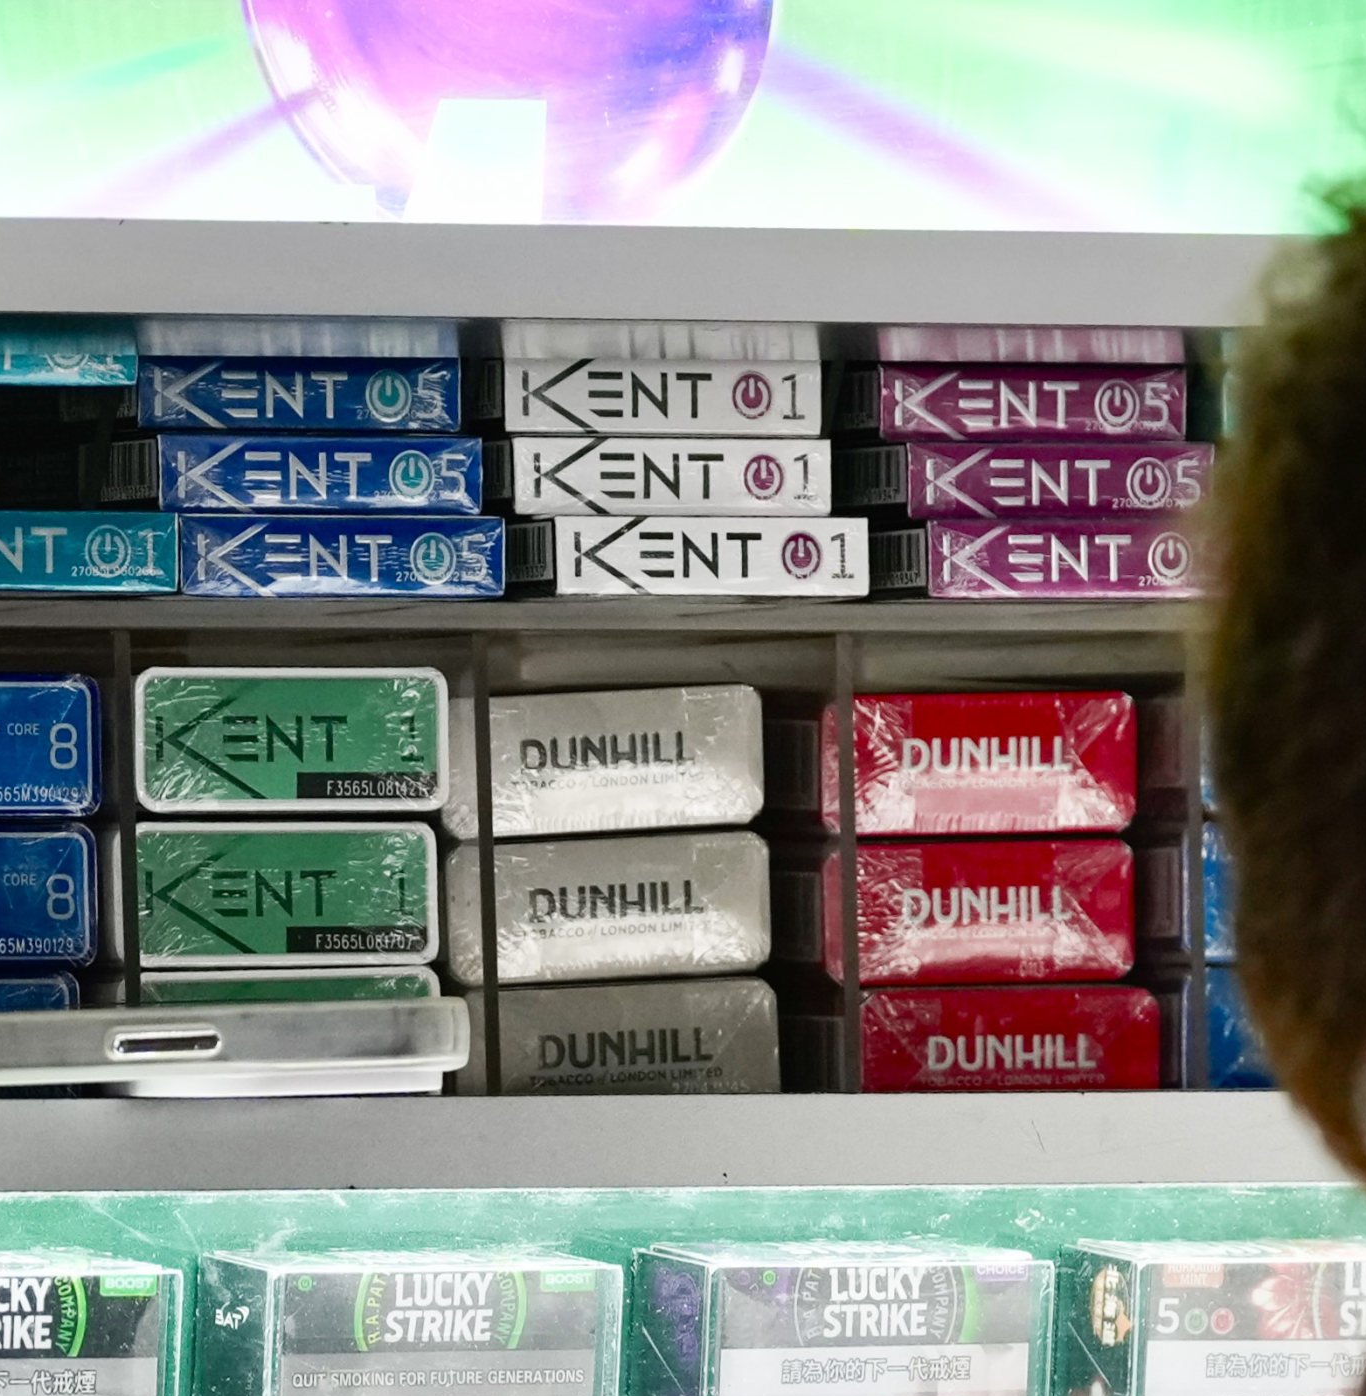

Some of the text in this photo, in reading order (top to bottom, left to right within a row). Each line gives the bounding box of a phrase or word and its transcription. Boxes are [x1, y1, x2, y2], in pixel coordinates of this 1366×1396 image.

[153, 357, 349, 429] KENT
[521, 358, 806, 433] KENT 1
[894, 371, 1168, 439] KENT 5
[177, 440, 373, 513] KENT
[533, 438, 819, 514] KENT 1
[925, 447, 1115, 518] KENT
[198, 517, 393, 596] KENT
[573, 517, 857, 595] KENT 1
[941, 525, 1133, 595] KENT
[7, 723, 40, 736] CORE
[48, 722, 79, 770] 8
[154, 698, 347, 799] KENT
[519, 729, 696, 772] DUNHILL
[901, 735, 1072, 774] DUNHILL
[3, 873, 36, 887] CORE
[45, 873, 76, 921] 8
[144, 853, 337, 954] KENT
[527, 879, 705, 924] DUNHILL
[904, 885, 1071, 925] DUNHILL
[538, 1026, 714, 1070] DUNHILL
[926, 1033, 1097, 1072] DUNHILL
[610, 1069, 666, 1084] LONDON
[393, 1271, 495, 1308] LUCKY
[544, 1272, 592, 1285] BOOST
[828, 1266, 925, 1302] LUCKY
[384, 1308, 494, 1343] STRIKE
[822, 1302, 928, 1338] STRIKE
[1156, 1297, 1180, 1335] 5
[292, 1368, 585, 1388] QUIT SMOKING FOR FUTURE GENERATIONS
[780, 1356, 972, 1385] 請為你的下一代戒煙
